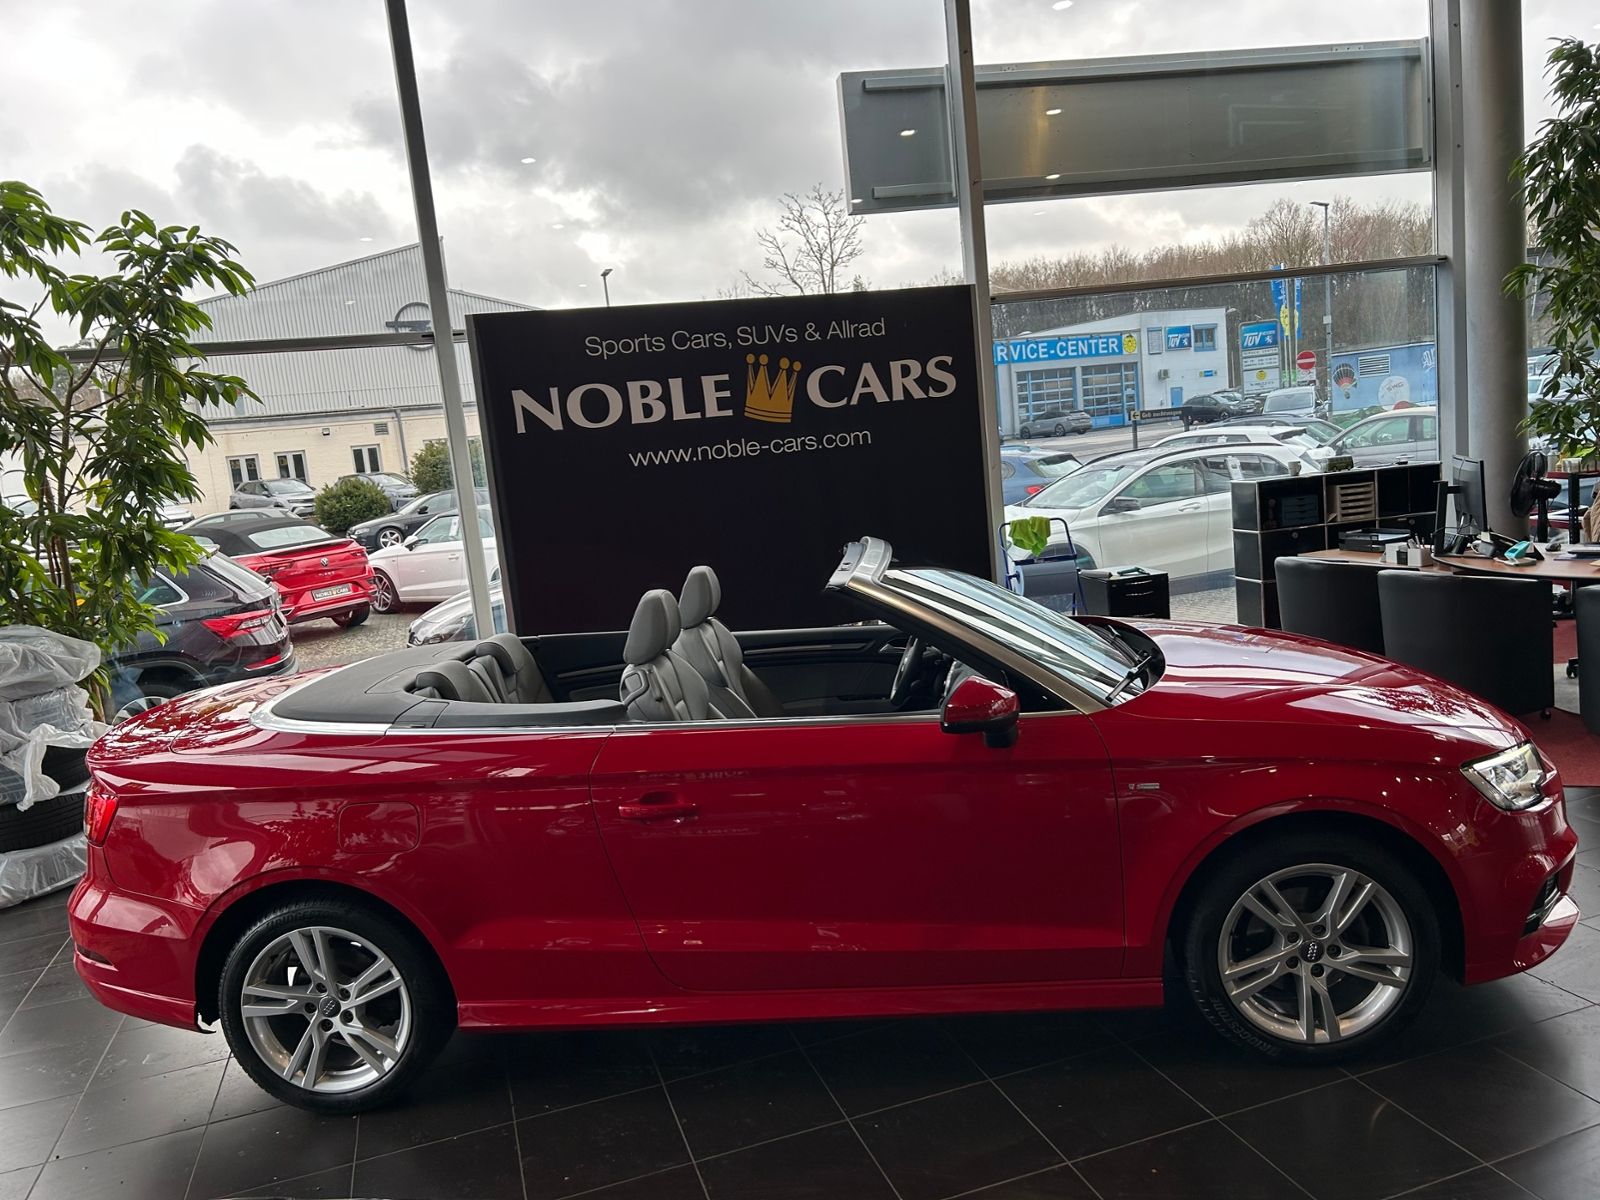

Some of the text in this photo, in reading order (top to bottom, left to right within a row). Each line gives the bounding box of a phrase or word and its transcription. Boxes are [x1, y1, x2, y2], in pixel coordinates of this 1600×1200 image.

[585, 317, 886, 360] Sports Cars, SUVs & Allrad
[996, 337, 1120, 362] RVICE-CENTER
[511, 355, 957, 434] NOBLE CARS
[628, 430, 873, 467] www.noble-cars.com
